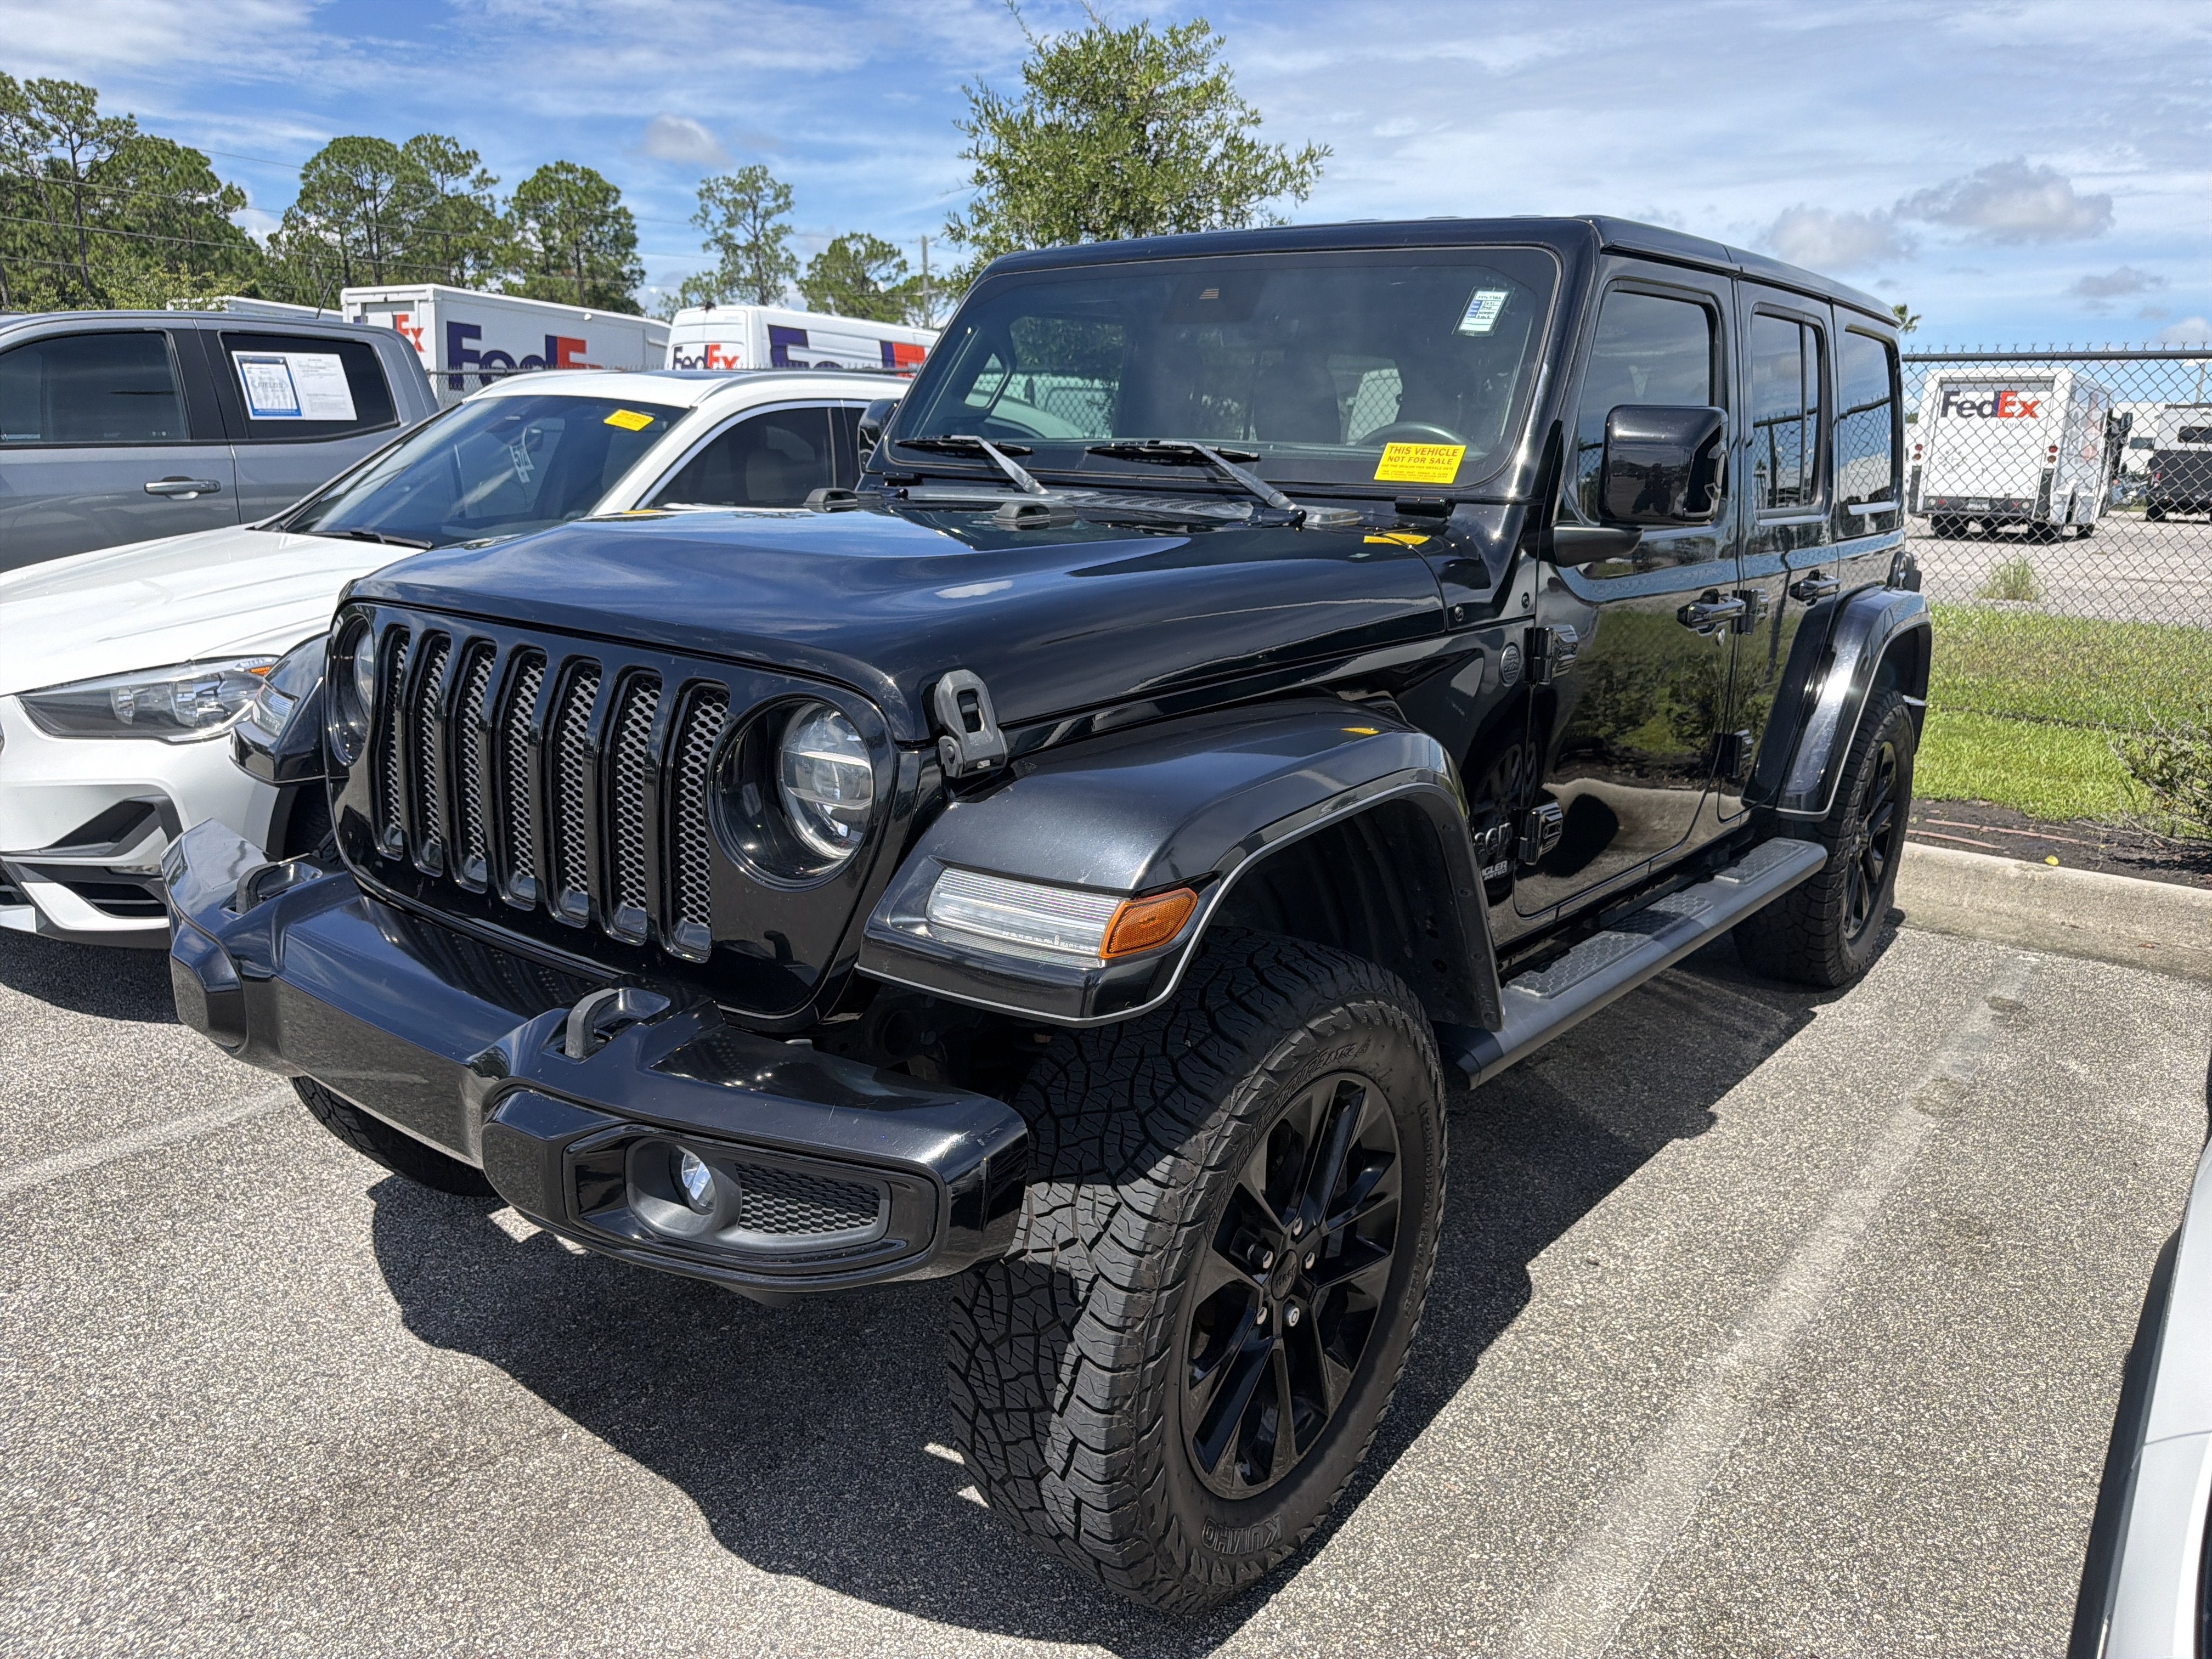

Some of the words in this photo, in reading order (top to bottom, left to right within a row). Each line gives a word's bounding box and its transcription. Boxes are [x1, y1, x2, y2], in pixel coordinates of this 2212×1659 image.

[447, 321, 603, 391] FedE
[1940, 391, 2041, 419] FedEx
[1389, 446, 1412, 455] THIS
[1415, 447, 1459, 456] VEHICLE
[1473, 822, 1512, 857] eep
[1482, 860, 1508, 877] GLER
[1202, 1513, 1282, 1554] KUMHO
